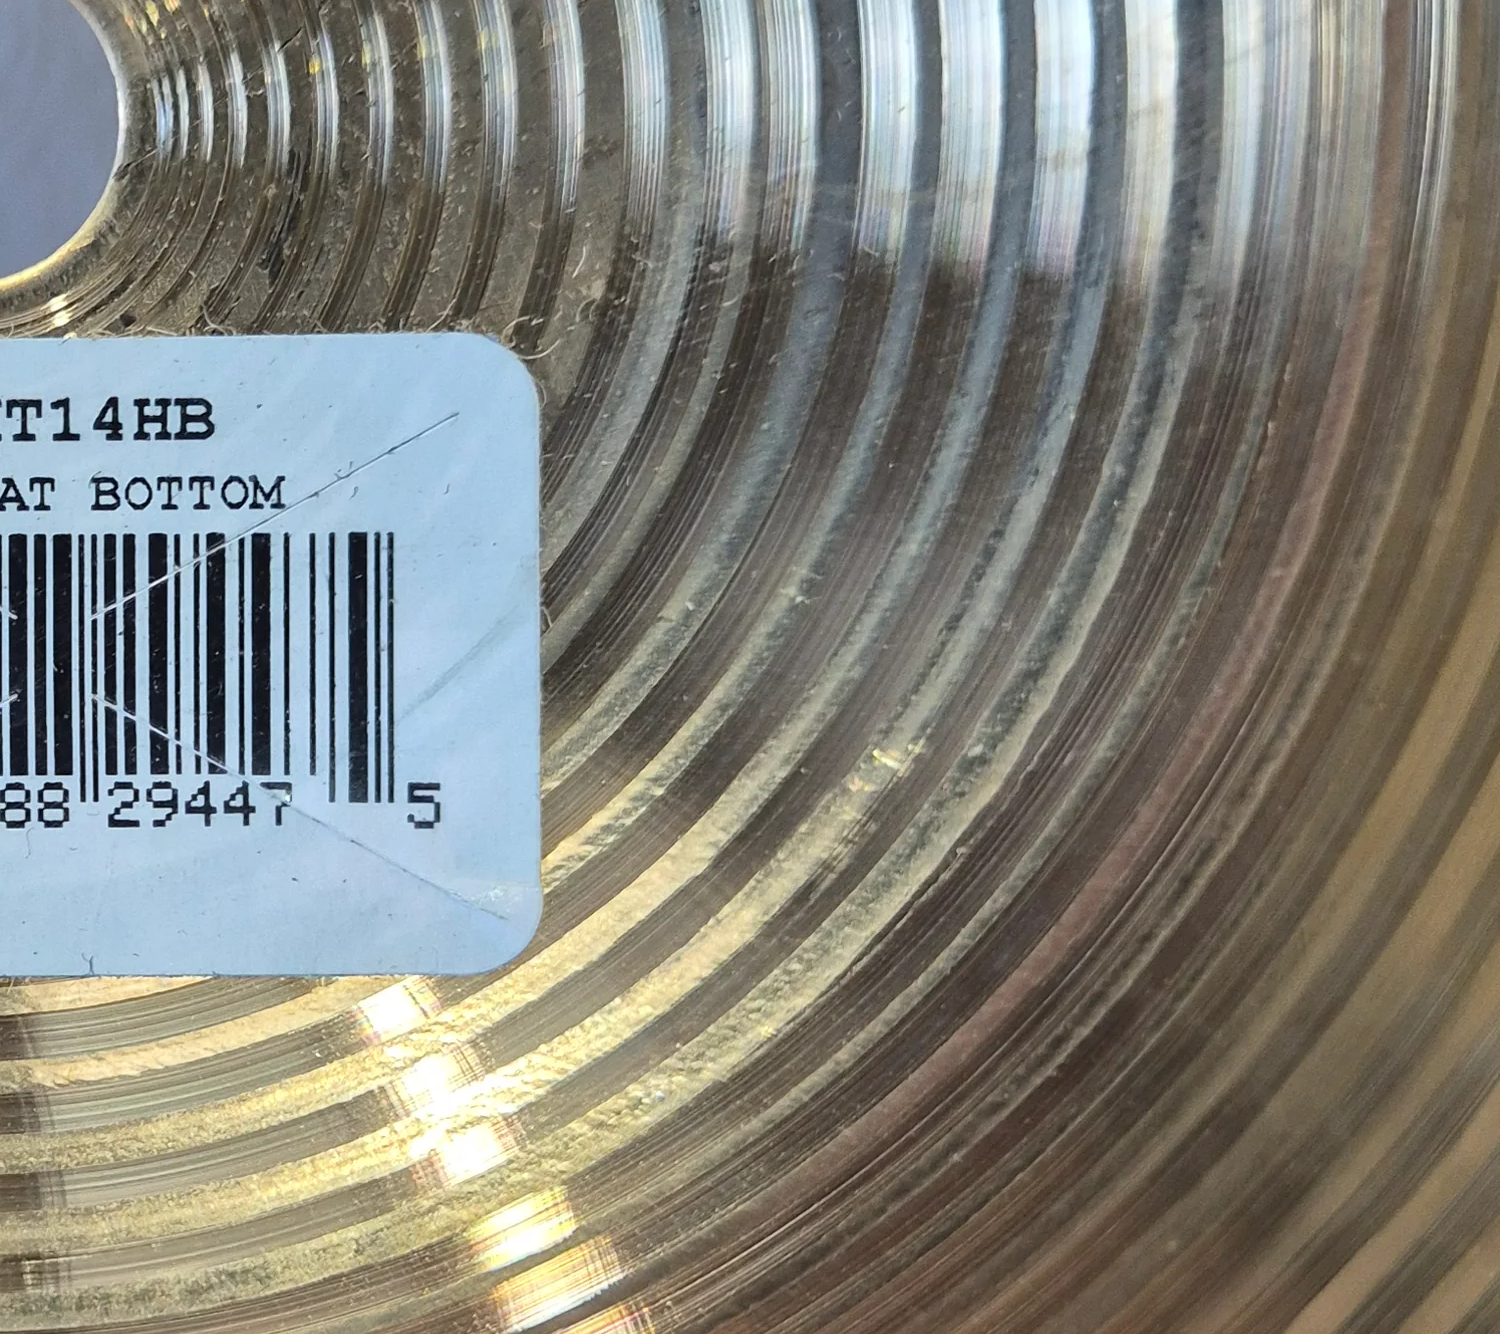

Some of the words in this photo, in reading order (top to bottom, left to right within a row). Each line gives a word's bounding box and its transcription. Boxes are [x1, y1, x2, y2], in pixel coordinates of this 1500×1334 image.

[89, 474, 287, 512] BOTTOM
[107, 780, 294, 828] 29447
[407, 782, 441, 829] 5
